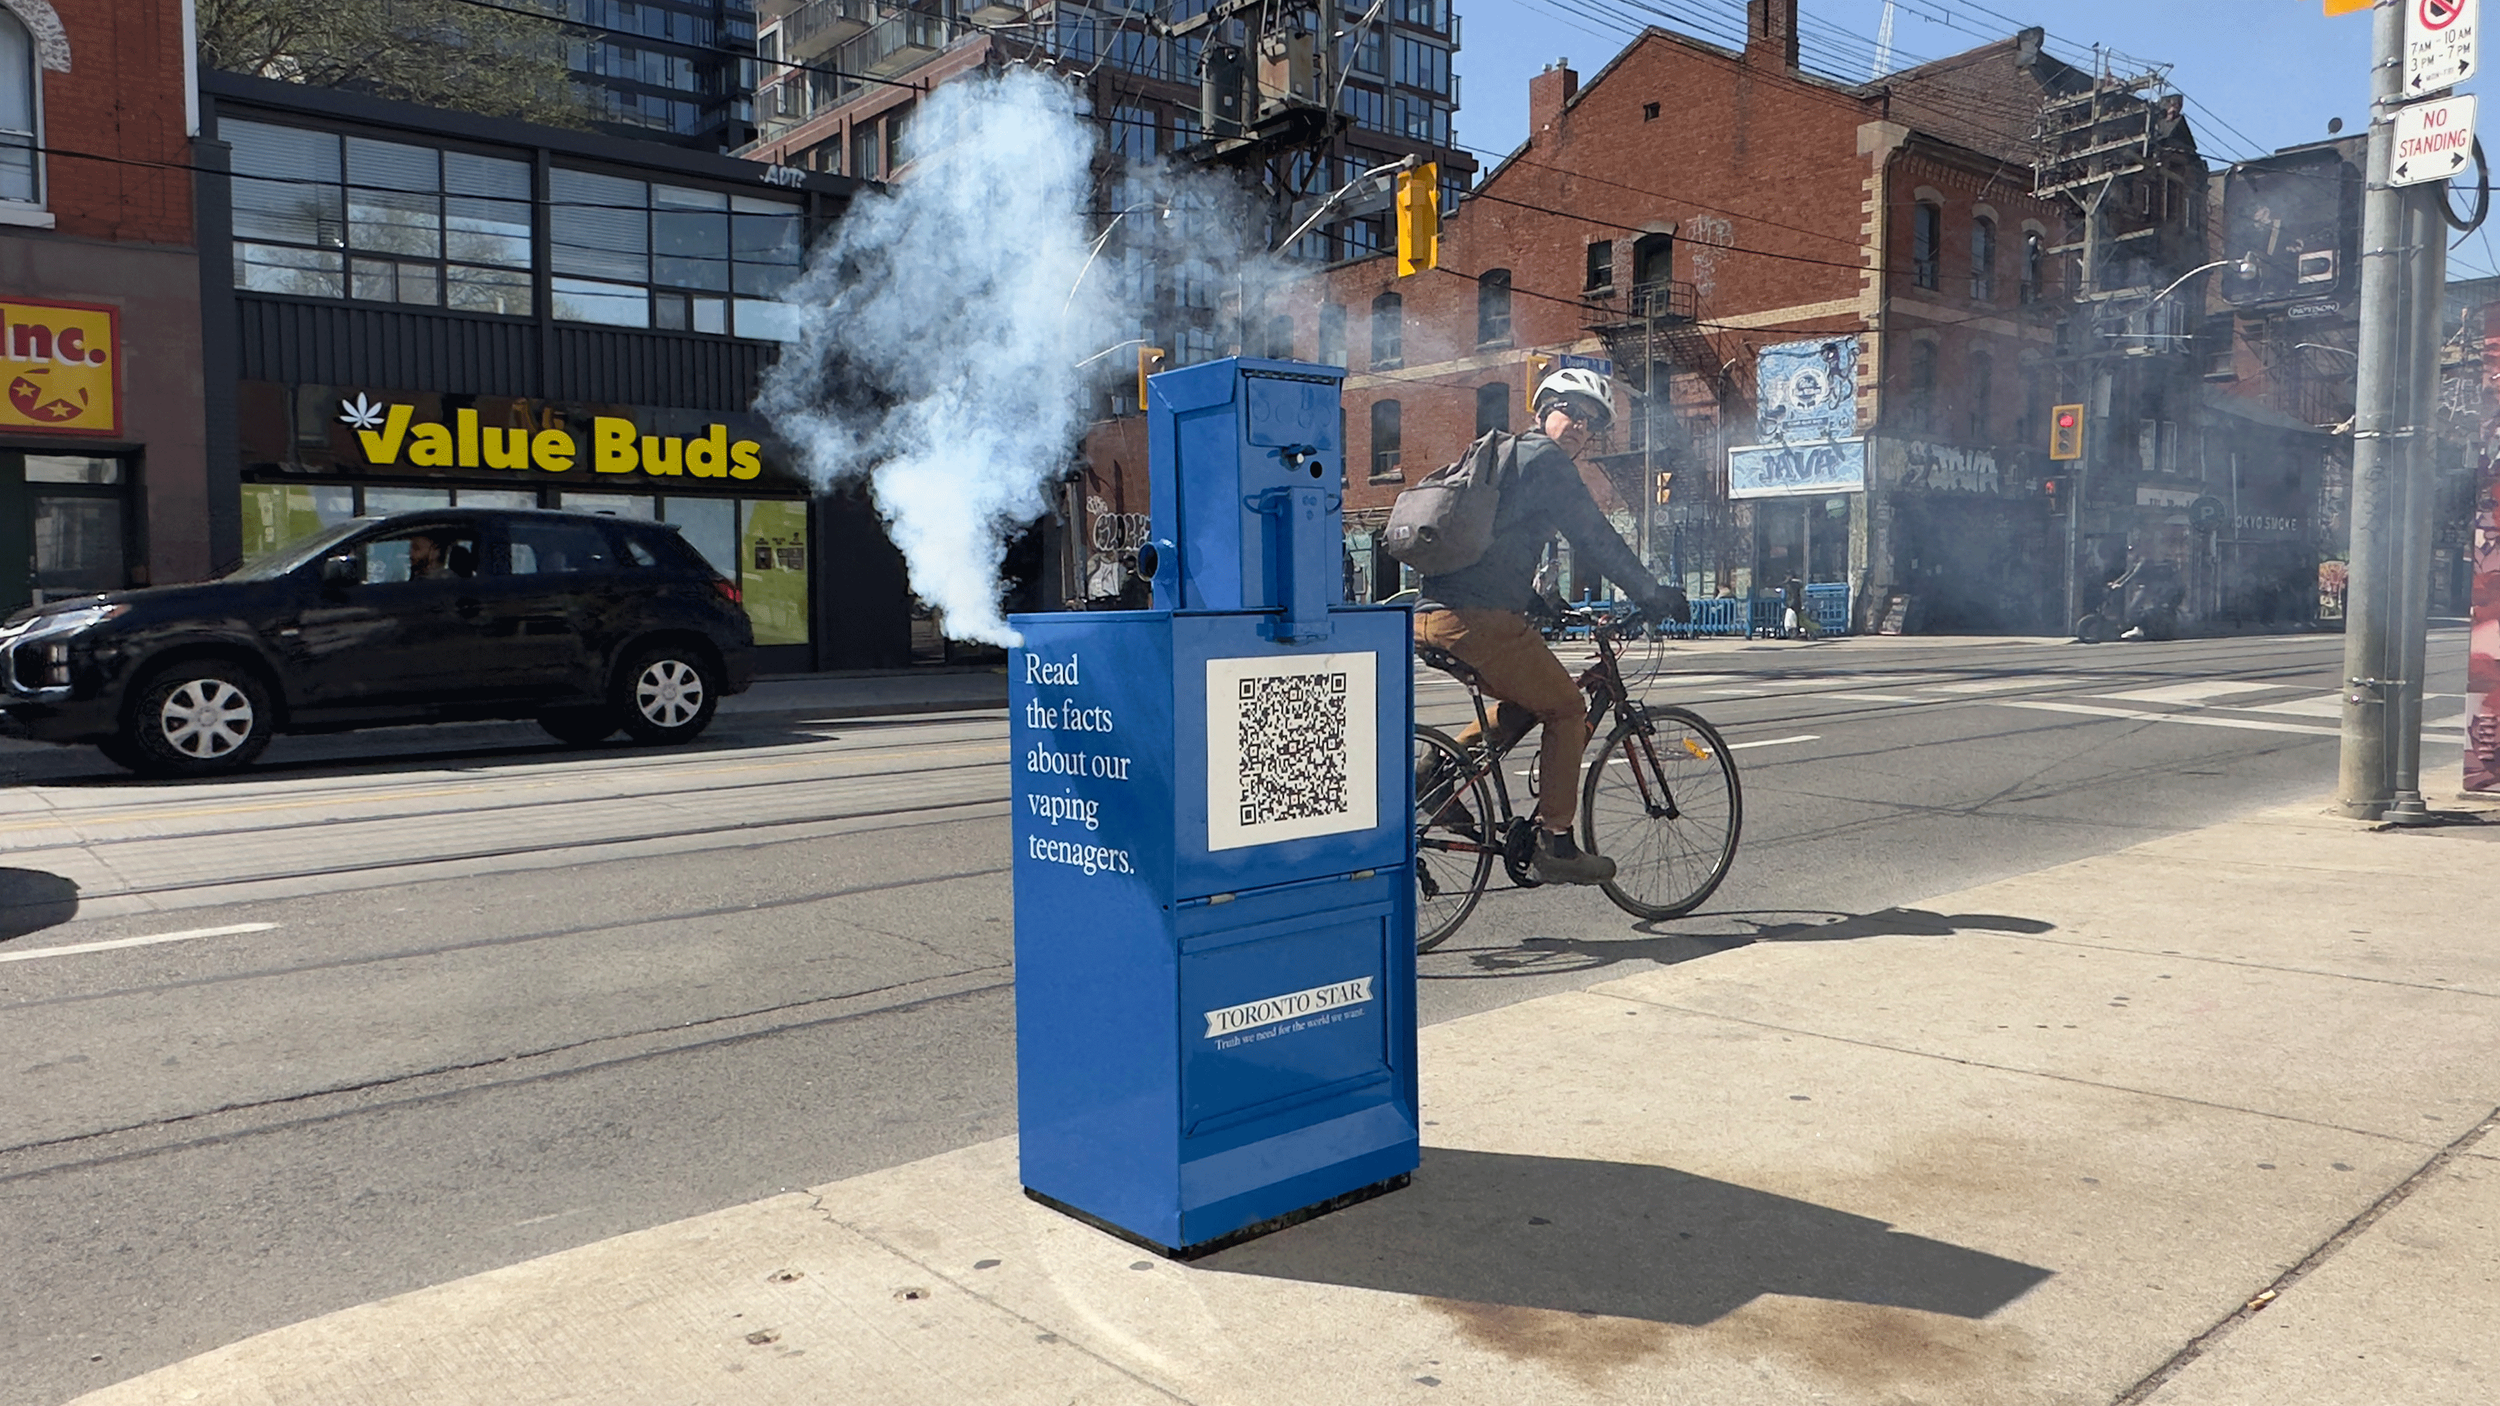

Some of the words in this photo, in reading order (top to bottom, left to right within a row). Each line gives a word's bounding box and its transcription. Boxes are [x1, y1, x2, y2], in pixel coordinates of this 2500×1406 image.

[2444, 29, 2456, 44] 10
[2458, 26, 2471, 39] AM
[2421, 54, 2434, 69] PM
[2448, 45, 2454, 59] 7
[2457, 42, 2471, 55] PM
[2423, 108, 2448, 130] NO
[2399, 129, 2467, 158] STANDING
[357, 403, 576, 473] Value
[594, 416, 762, 480] Buds
[1759, 448, 1838, 480] JAVA
[2265, 516, 2297, 532] SMOKE
[1025, 653, 1080, 685] Read
[1026, 697, 1058, 730] the
[1062, 698, 1113, 733] facts
[1027, 741, 1088, 777] about
[1091, 755, 1131, 780] our
[1027, 787, 1099, 831] vaping
[1028, 834, 1135, 876] teenagers.
[1216, 993, 1310, 1030] TORONTO
[1315, 983, 1363, 1009] STAR
[1214, 1035, 1241, 1050] Truth
[1242, 1033, 1255, 1043] we
[1256, 1026, 1277, 1041] need
[1278, 1024, 1291, 1036] for
[1292, 1020, 1306, 1032] the
[1307, 1013, 1330, 1028] world
[1330, 1012, 1343, 1023] we
